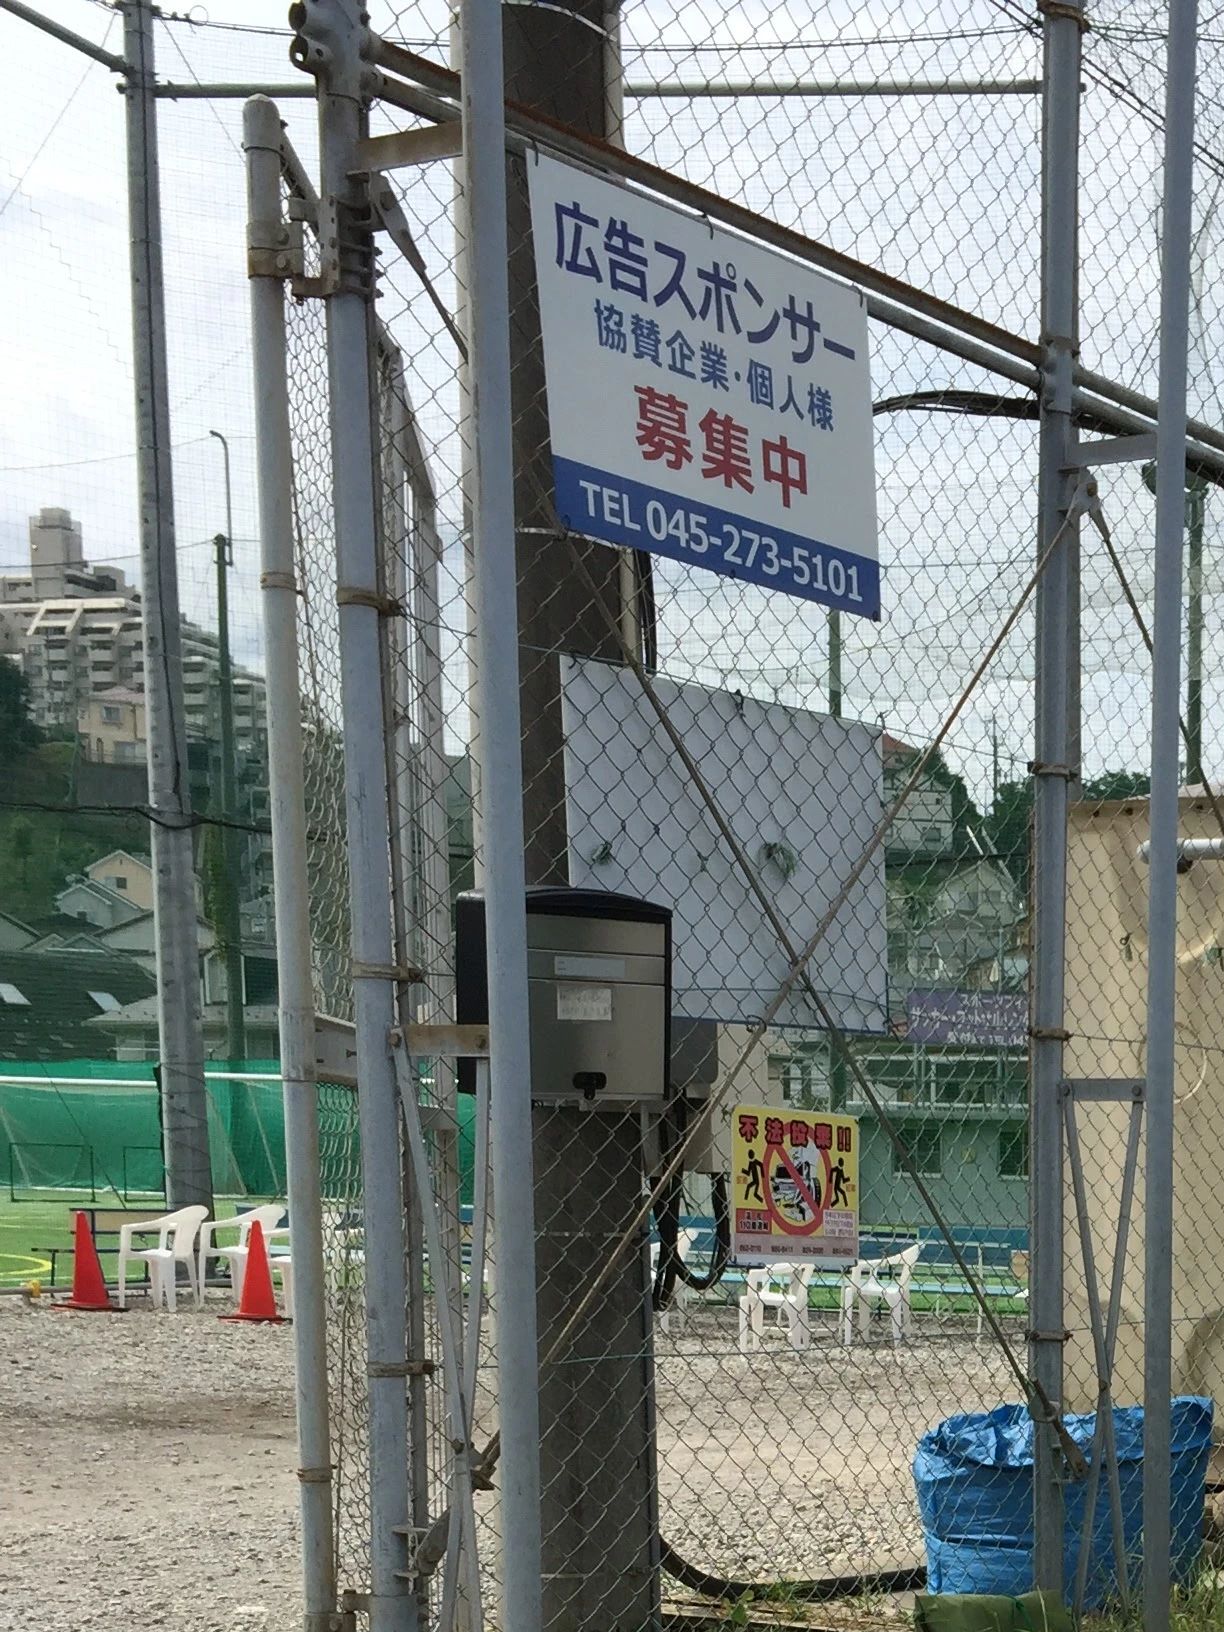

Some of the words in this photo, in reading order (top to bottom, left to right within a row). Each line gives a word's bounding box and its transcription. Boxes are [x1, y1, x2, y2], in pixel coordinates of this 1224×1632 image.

[554, 201, 855, 365] 広告スポンサー
[594, 298, 834, 432] 協賛企業・個人様
[634, 385, 809, 509] 募集中
[579, 480, 641, 531] TEL
[646, 500, 863, 602] 045-273-5101
